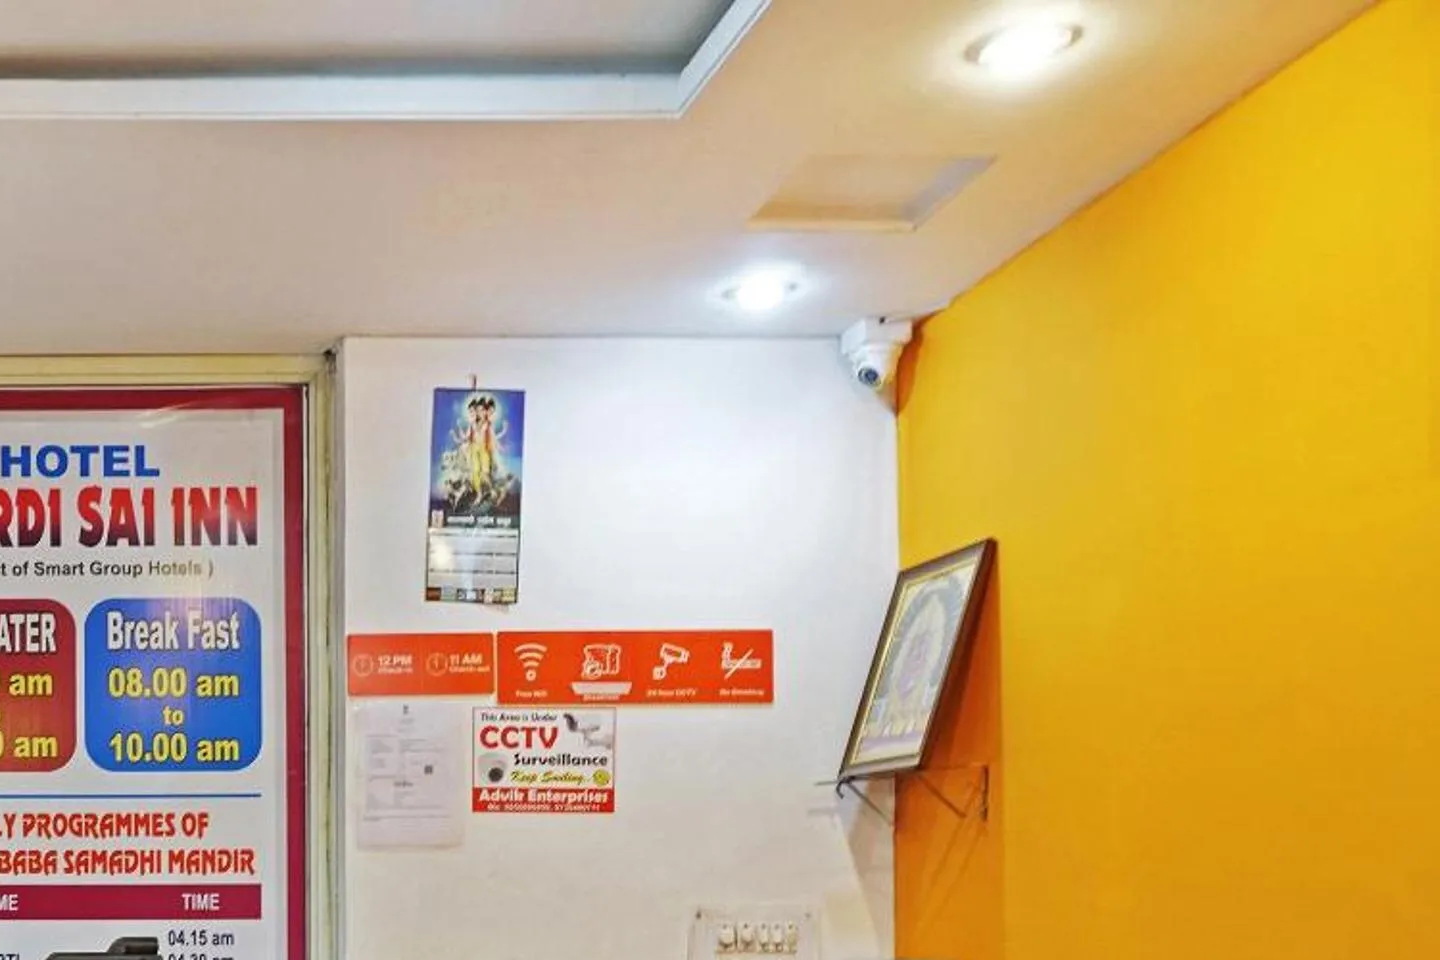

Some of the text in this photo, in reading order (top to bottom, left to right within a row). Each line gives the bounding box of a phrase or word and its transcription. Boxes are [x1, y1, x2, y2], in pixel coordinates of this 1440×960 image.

[0, 445, 159, 478] HOTEL
[77, 485, 156, 548] SAI
[171, 486, 258, 547] INN
[12, 561, 29, 577] of
[33, 561, 85, 577] Smart
[89, 561, 142, 579] Group
[148, 561, 202, 577] Hotels
[106, 610, 240, 650] Break Fast
[392, 654, 413, 666] PM
[462, 653, 482, 665] AM
[9, 672, 53, 696] am
[108, 667, 240, 698] 08.00 am
[162, 705, 184, 726] to
[14, 735, 58, 758] am
[110, 733, 240, 763] 10.00 am
[480, 725, 558, 749] CCTV
[514, 753, 608, 766] Surveillance
[527, 788, 608, 804] Enterprises
[22, 812, 175, 840] PROGRAMMES
[181, 812, 209, 840] OF
[63, 849, 162, 876] SAMADHI
[168, 849, 255, 876] MANDIR
[182, 893, 219, 911] TIME
[168, 929, 235, 946] 04.15 am
